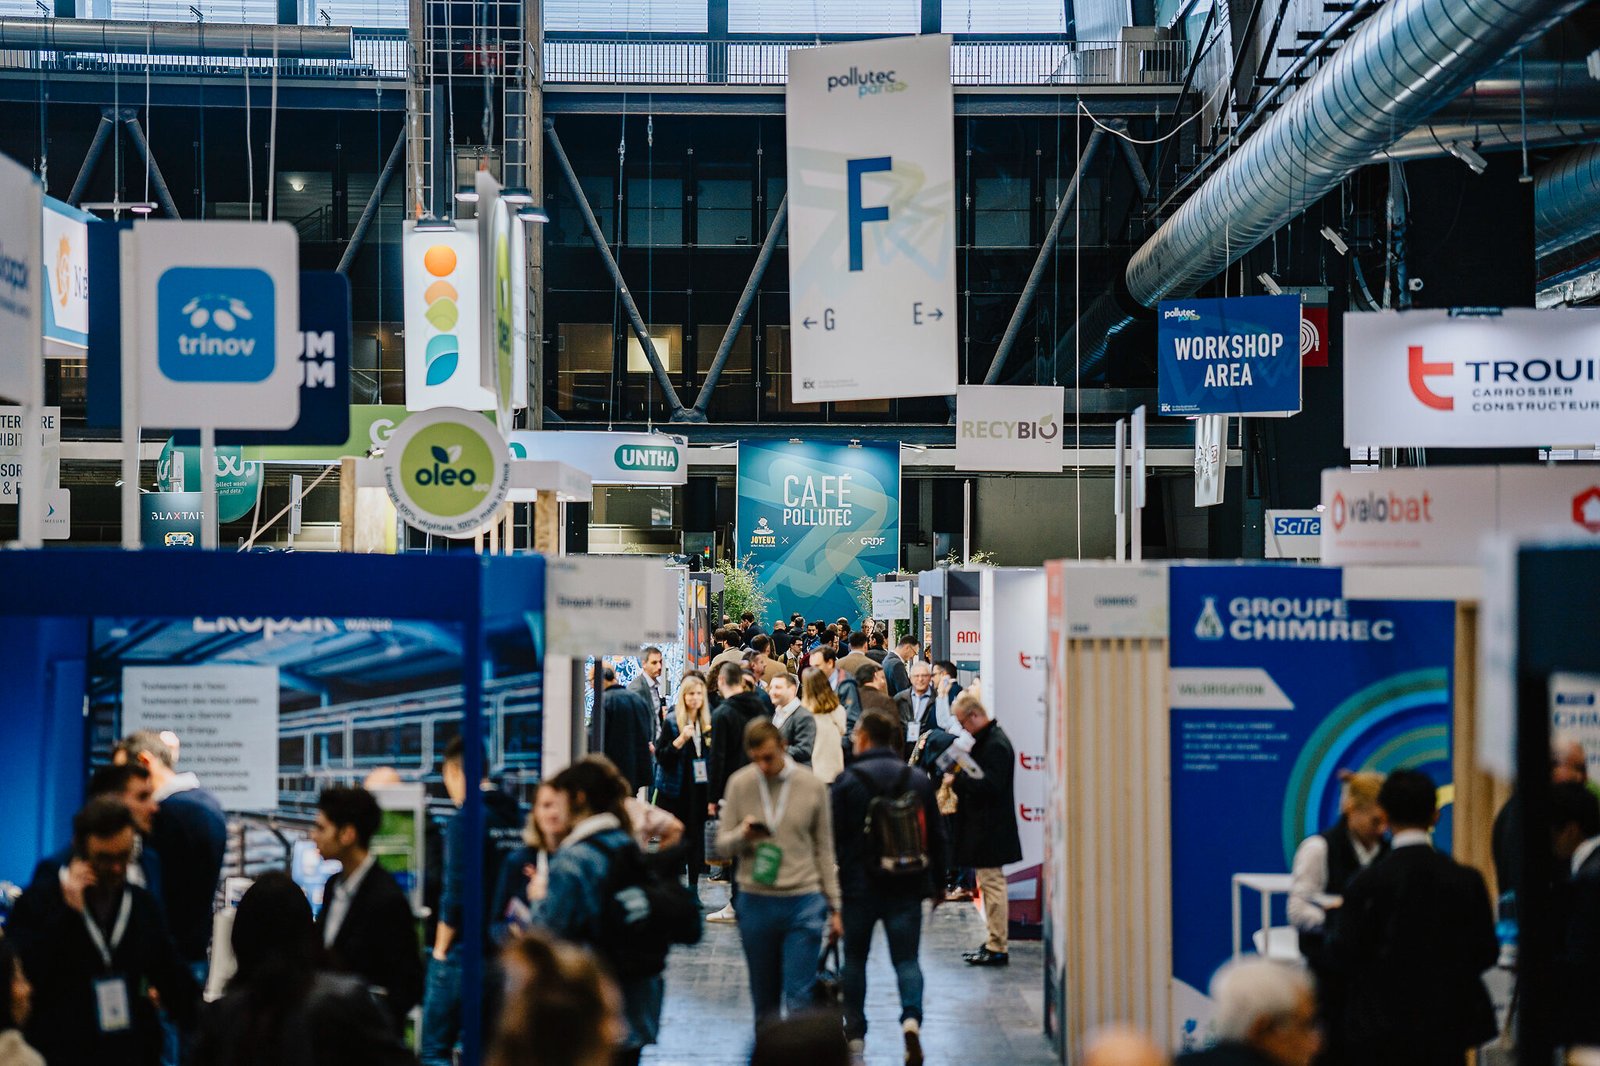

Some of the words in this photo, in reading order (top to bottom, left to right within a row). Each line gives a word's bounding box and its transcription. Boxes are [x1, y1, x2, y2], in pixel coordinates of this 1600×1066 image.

[827, 66, 896, 92] pollutec
[847, 157, 891, 271] F
[824, 308, 835, 331] G
[913, 302, 923, 325] E
[178, 332, 256, 356] trinov
[1174, 333, 1284, 361] WORKSHOP
[1204, 363, 1253, 388] AREA
[1472, 387, 1573, 397] CARROSSIER
[961, 420, 1058, 440] RECYBIO
[622, 449, 676, 467] UNTHA
[415, 462, 476, 486] oleo
[783, 473, 852, 508] CAFÉ
[783, 509, 852, 526] POLLUTEC
[1348, 490, 1433, 523] valobat
[750, 535, 776, 544] JOYEUX
[860, 537, 886, 546] GRDF
[1229, 597, 1347, 618] GROUPE
[1229, 620, 1394, 641] CHIMIREC
